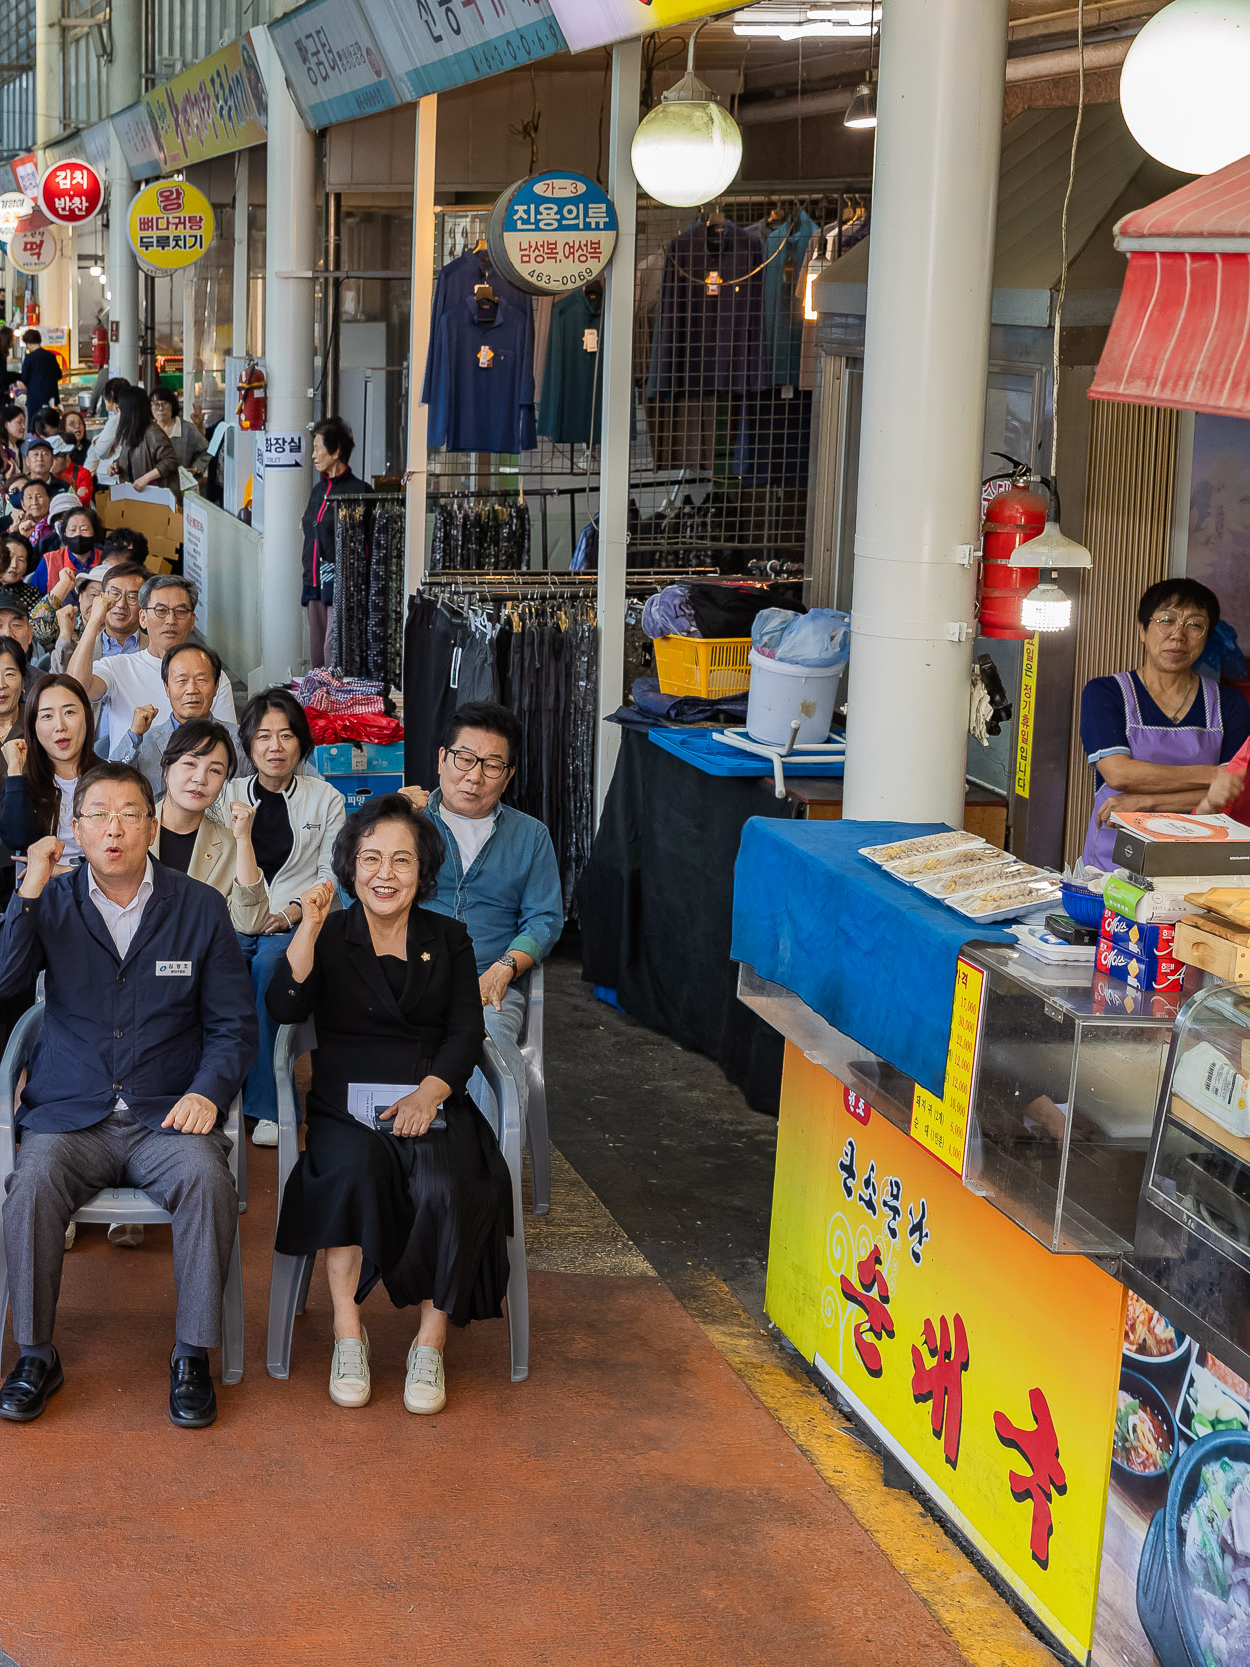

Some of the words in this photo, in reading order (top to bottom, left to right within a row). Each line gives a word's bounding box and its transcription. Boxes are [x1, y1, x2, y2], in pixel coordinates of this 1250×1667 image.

[54, 169, 88, 190] 김치
[542, 181, 579, 196] 가-3
[54, 197, 89, 216] 반찬
[156, 185, 185, 214] 왕
[138, 215, 205, 233] 뼈다귀탕
[512, 203, 609, 230] 진용의류
[22, 239, 45, 261] 떡
[138, 233, 204, 252] 두루치기
[527, 267, 594, 286] 463-0069
[265, 436, 302, 453] 화장실
[1017, 684, 1033, 793] 정기휴일입니다
[960, 996, 977, 1015] 17,000
[956, 1034, 973, 1053] 22,000
[954, 1053, 970, 1073] 12,000
[951, 1076, 968, 1095] 12,000
[950, 1097, 966, 1117] 10,000
[949, 1121, 964, 1140] 6,000
[948, 1144, 962, 1162] 4,000
[840, 1244, 1067, 1570] 순대국
